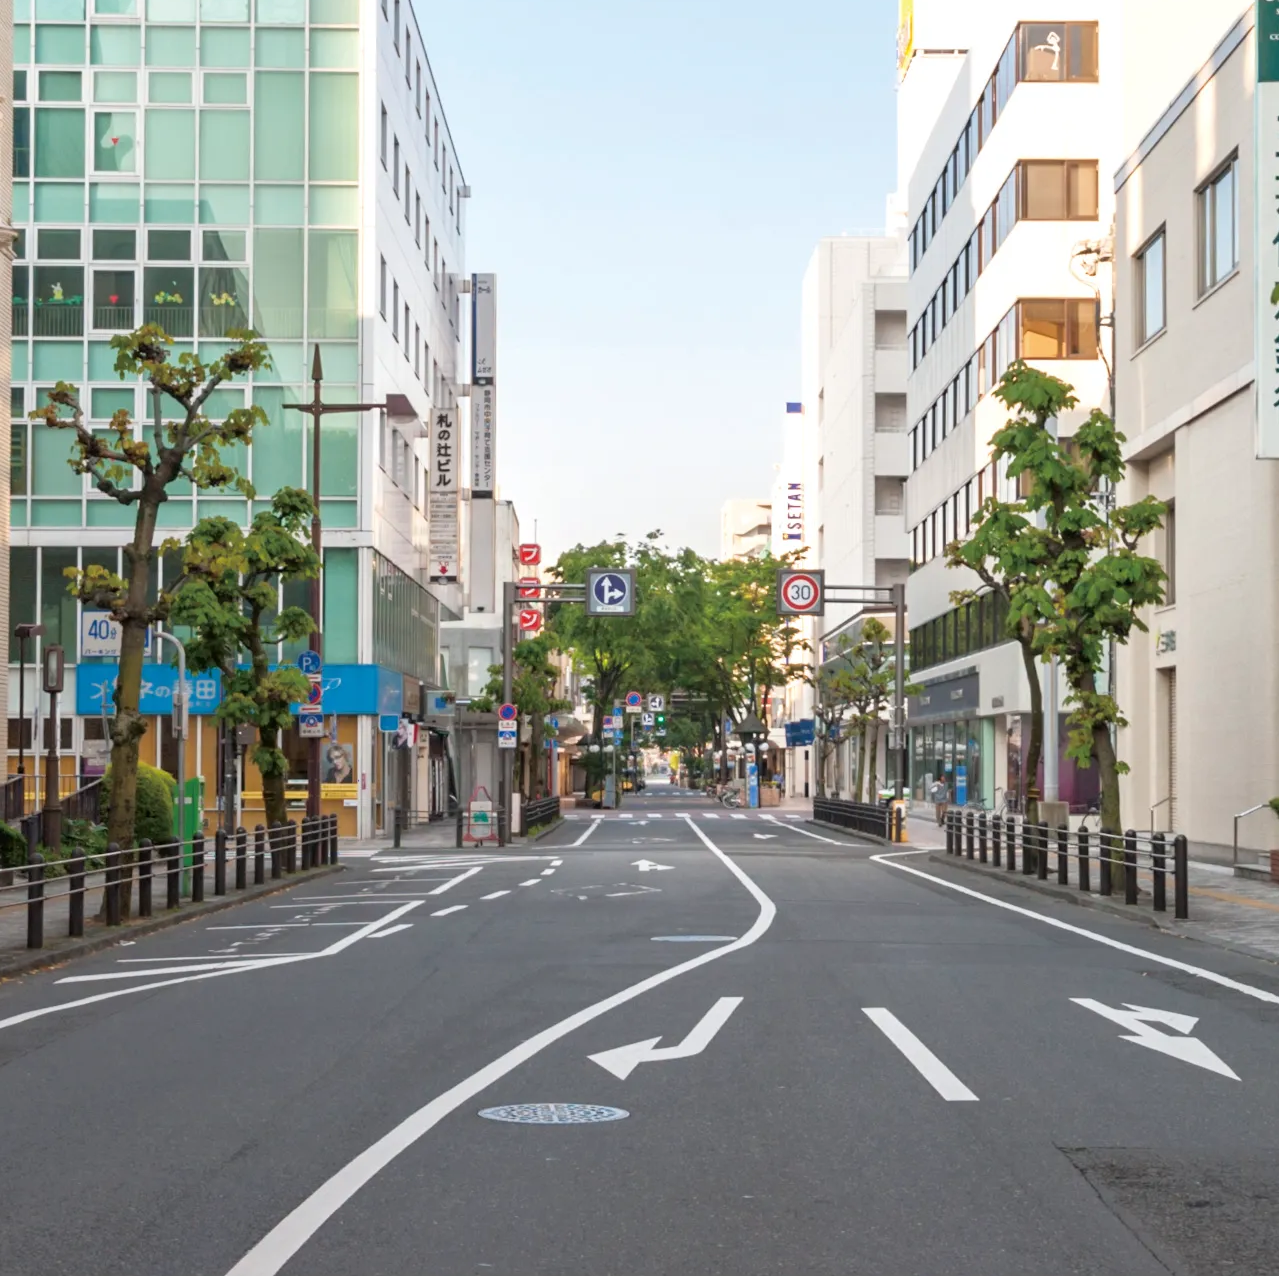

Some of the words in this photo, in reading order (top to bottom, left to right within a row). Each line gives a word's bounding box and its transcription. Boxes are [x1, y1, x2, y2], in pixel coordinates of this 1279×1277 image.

[436, 413, 452, 487] 札の辻ビル
[782, 482, 802, 540] ISETAN
[791, 584, 811, 601] 30
[302, 656, 312, 671] P
